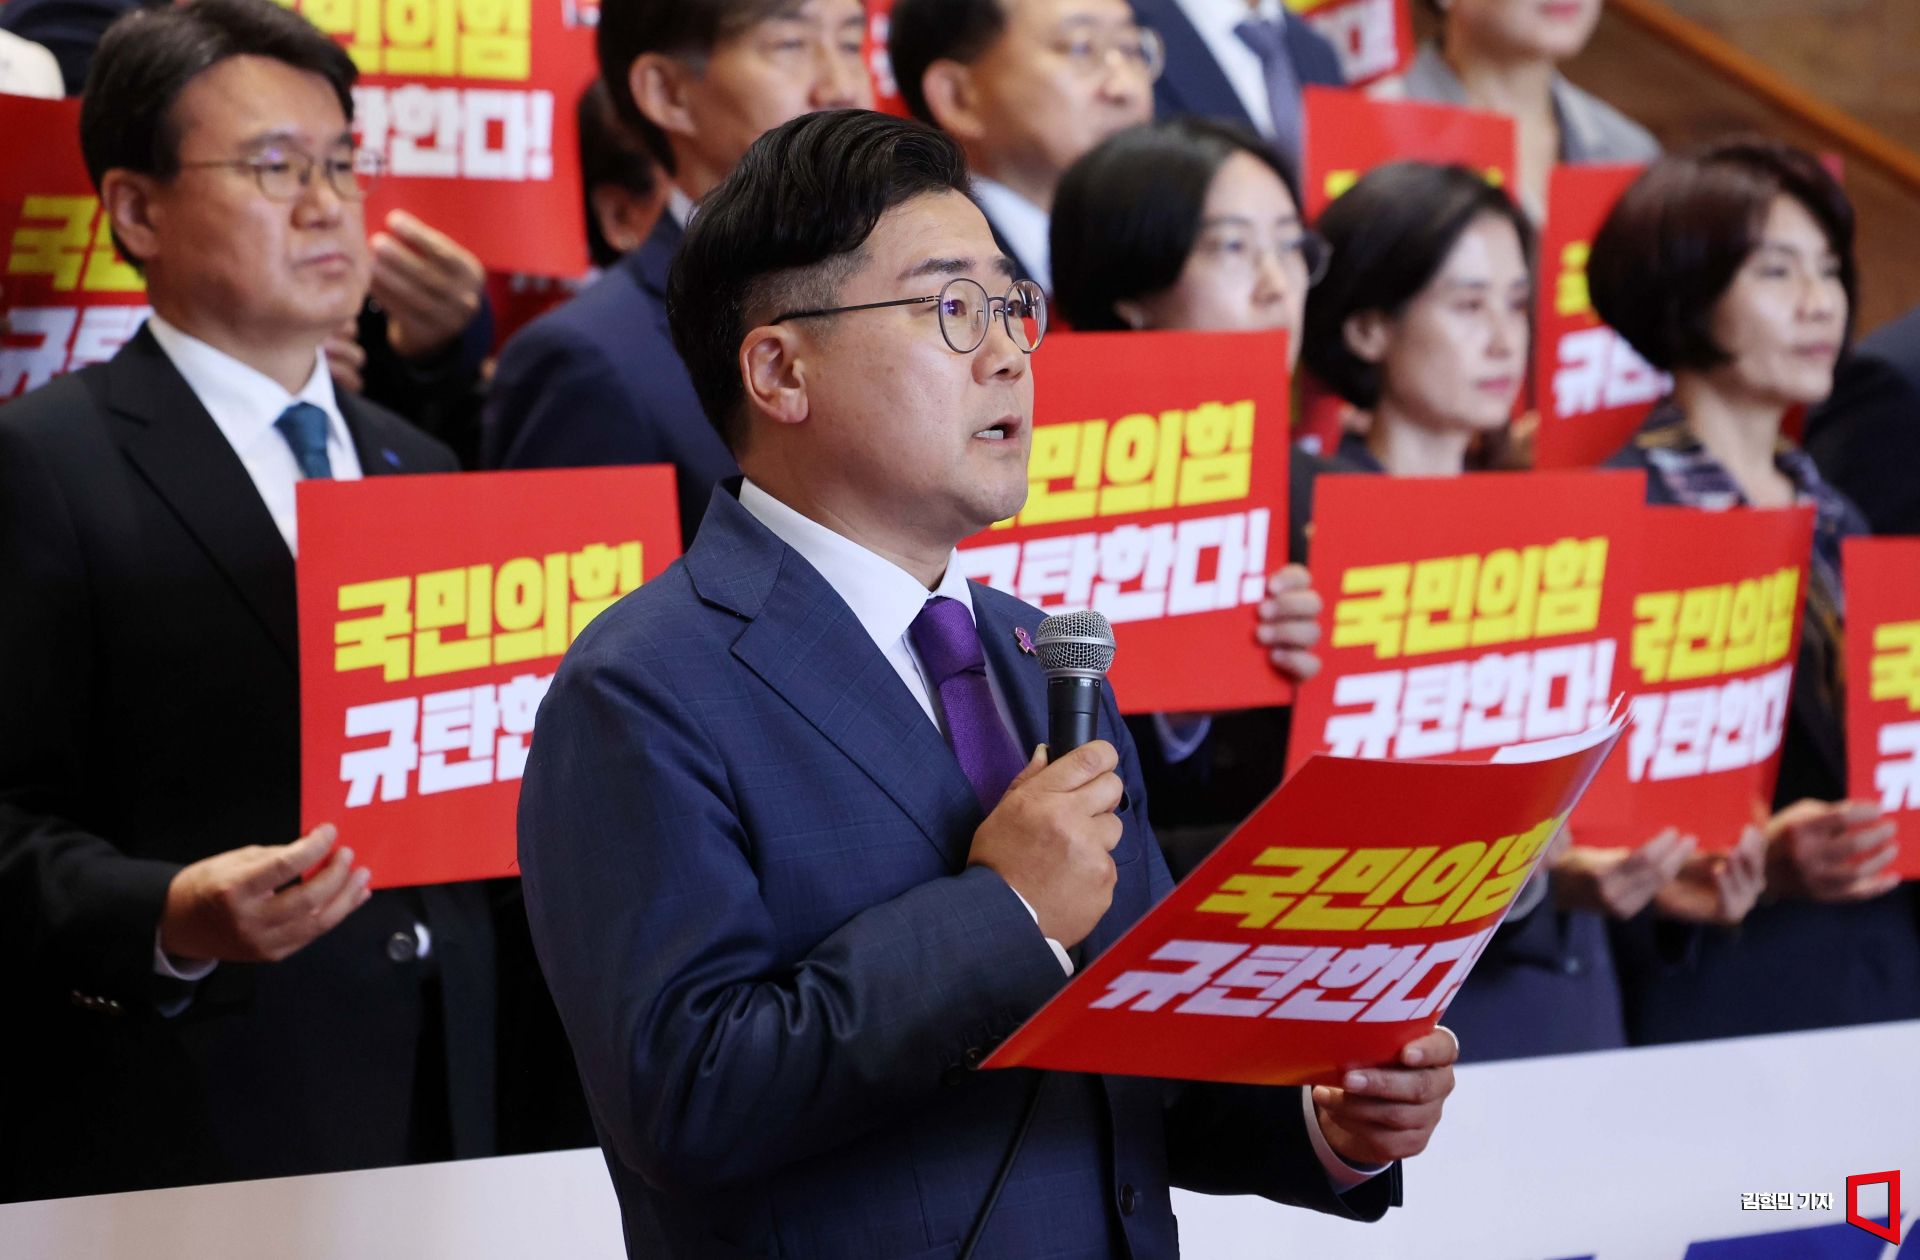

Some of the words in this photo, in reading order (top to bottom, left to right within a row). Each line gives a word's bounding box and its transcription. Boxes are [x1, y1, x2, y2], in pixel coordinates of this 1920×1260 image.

[276, 0, 531, 80] 민의힘
[991, 400, 1256, 531] 민의힘
[334, 541, 644, 683] 국민의힘
[1331, 537, 1609, 660] 국민의힘
[1323, 639, 1617, 759] 규탄한다!
[1196, 808, 1568, 931] 국민의힘
